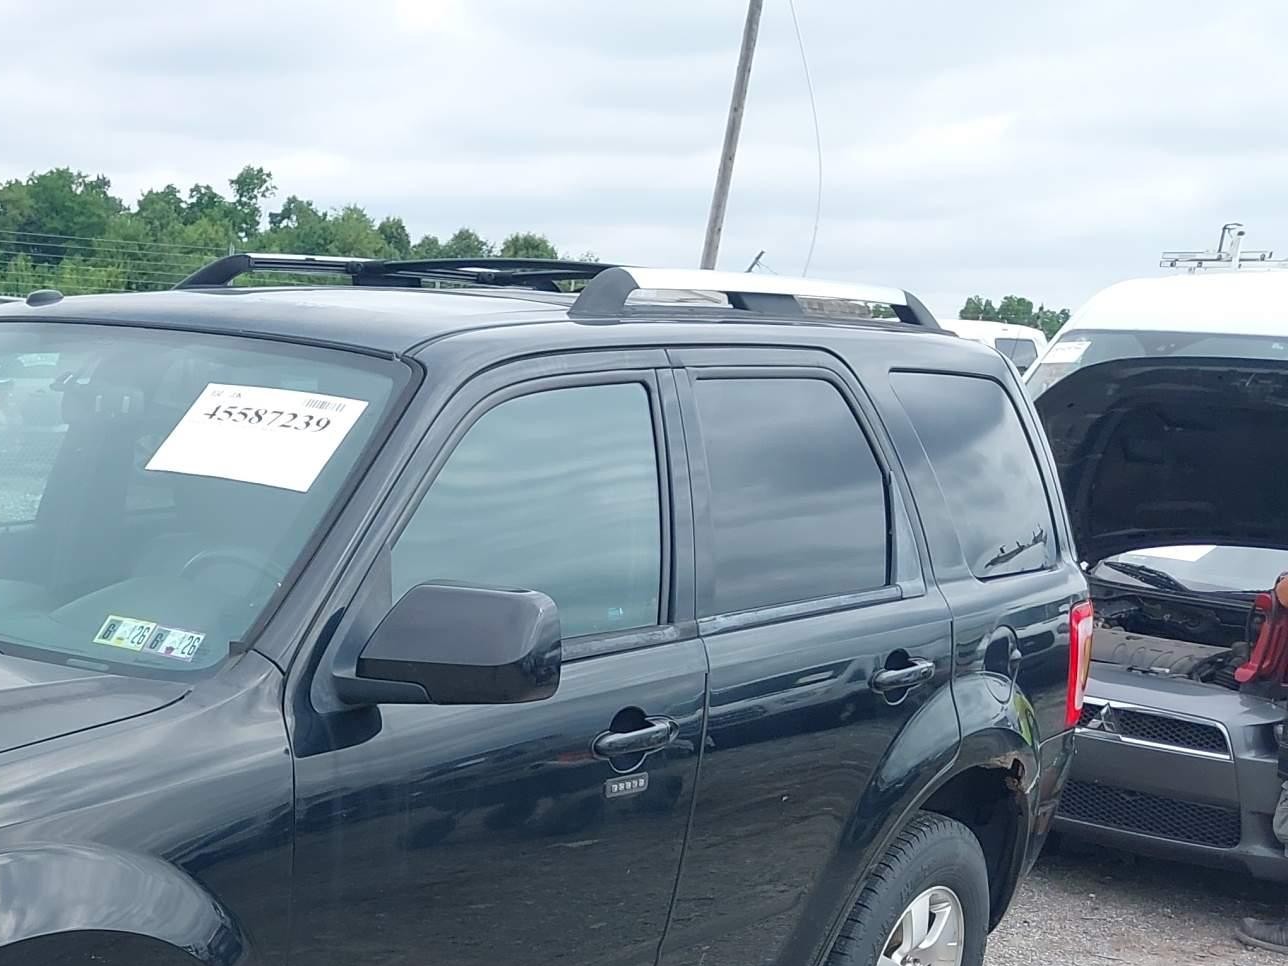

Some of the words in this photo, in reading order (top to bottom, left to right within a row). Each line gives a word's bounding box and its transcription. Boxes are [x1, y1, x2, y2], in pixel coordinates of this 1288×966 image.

[203, 404, 331, 432] 45587239
[130, 625, 151, 645] 26
[181, 635, 201, 656] 26
